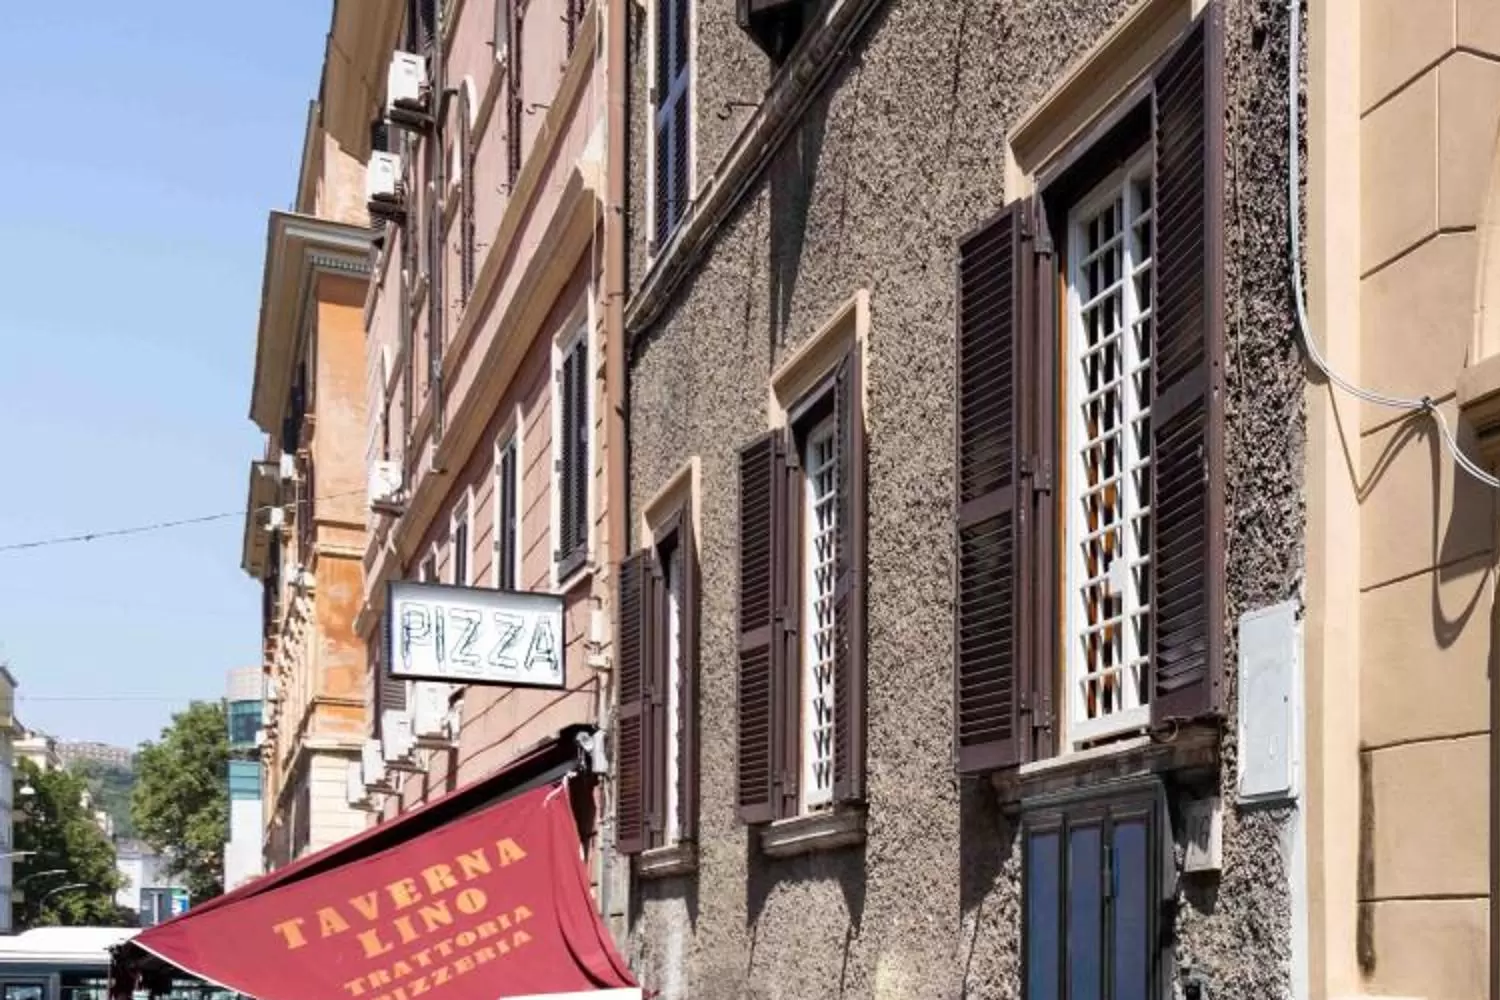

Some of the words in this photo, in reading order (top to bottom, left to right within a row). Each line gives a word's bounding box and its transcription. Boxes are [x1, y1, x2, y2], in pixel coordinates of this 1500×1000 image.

[400, 602, 558, 673] PIZZA
[272, 837, 527, 950] TAVERNA
[356, 887, 488, 959] LINO
[344, 905, 534, 997] TRATTORIA
